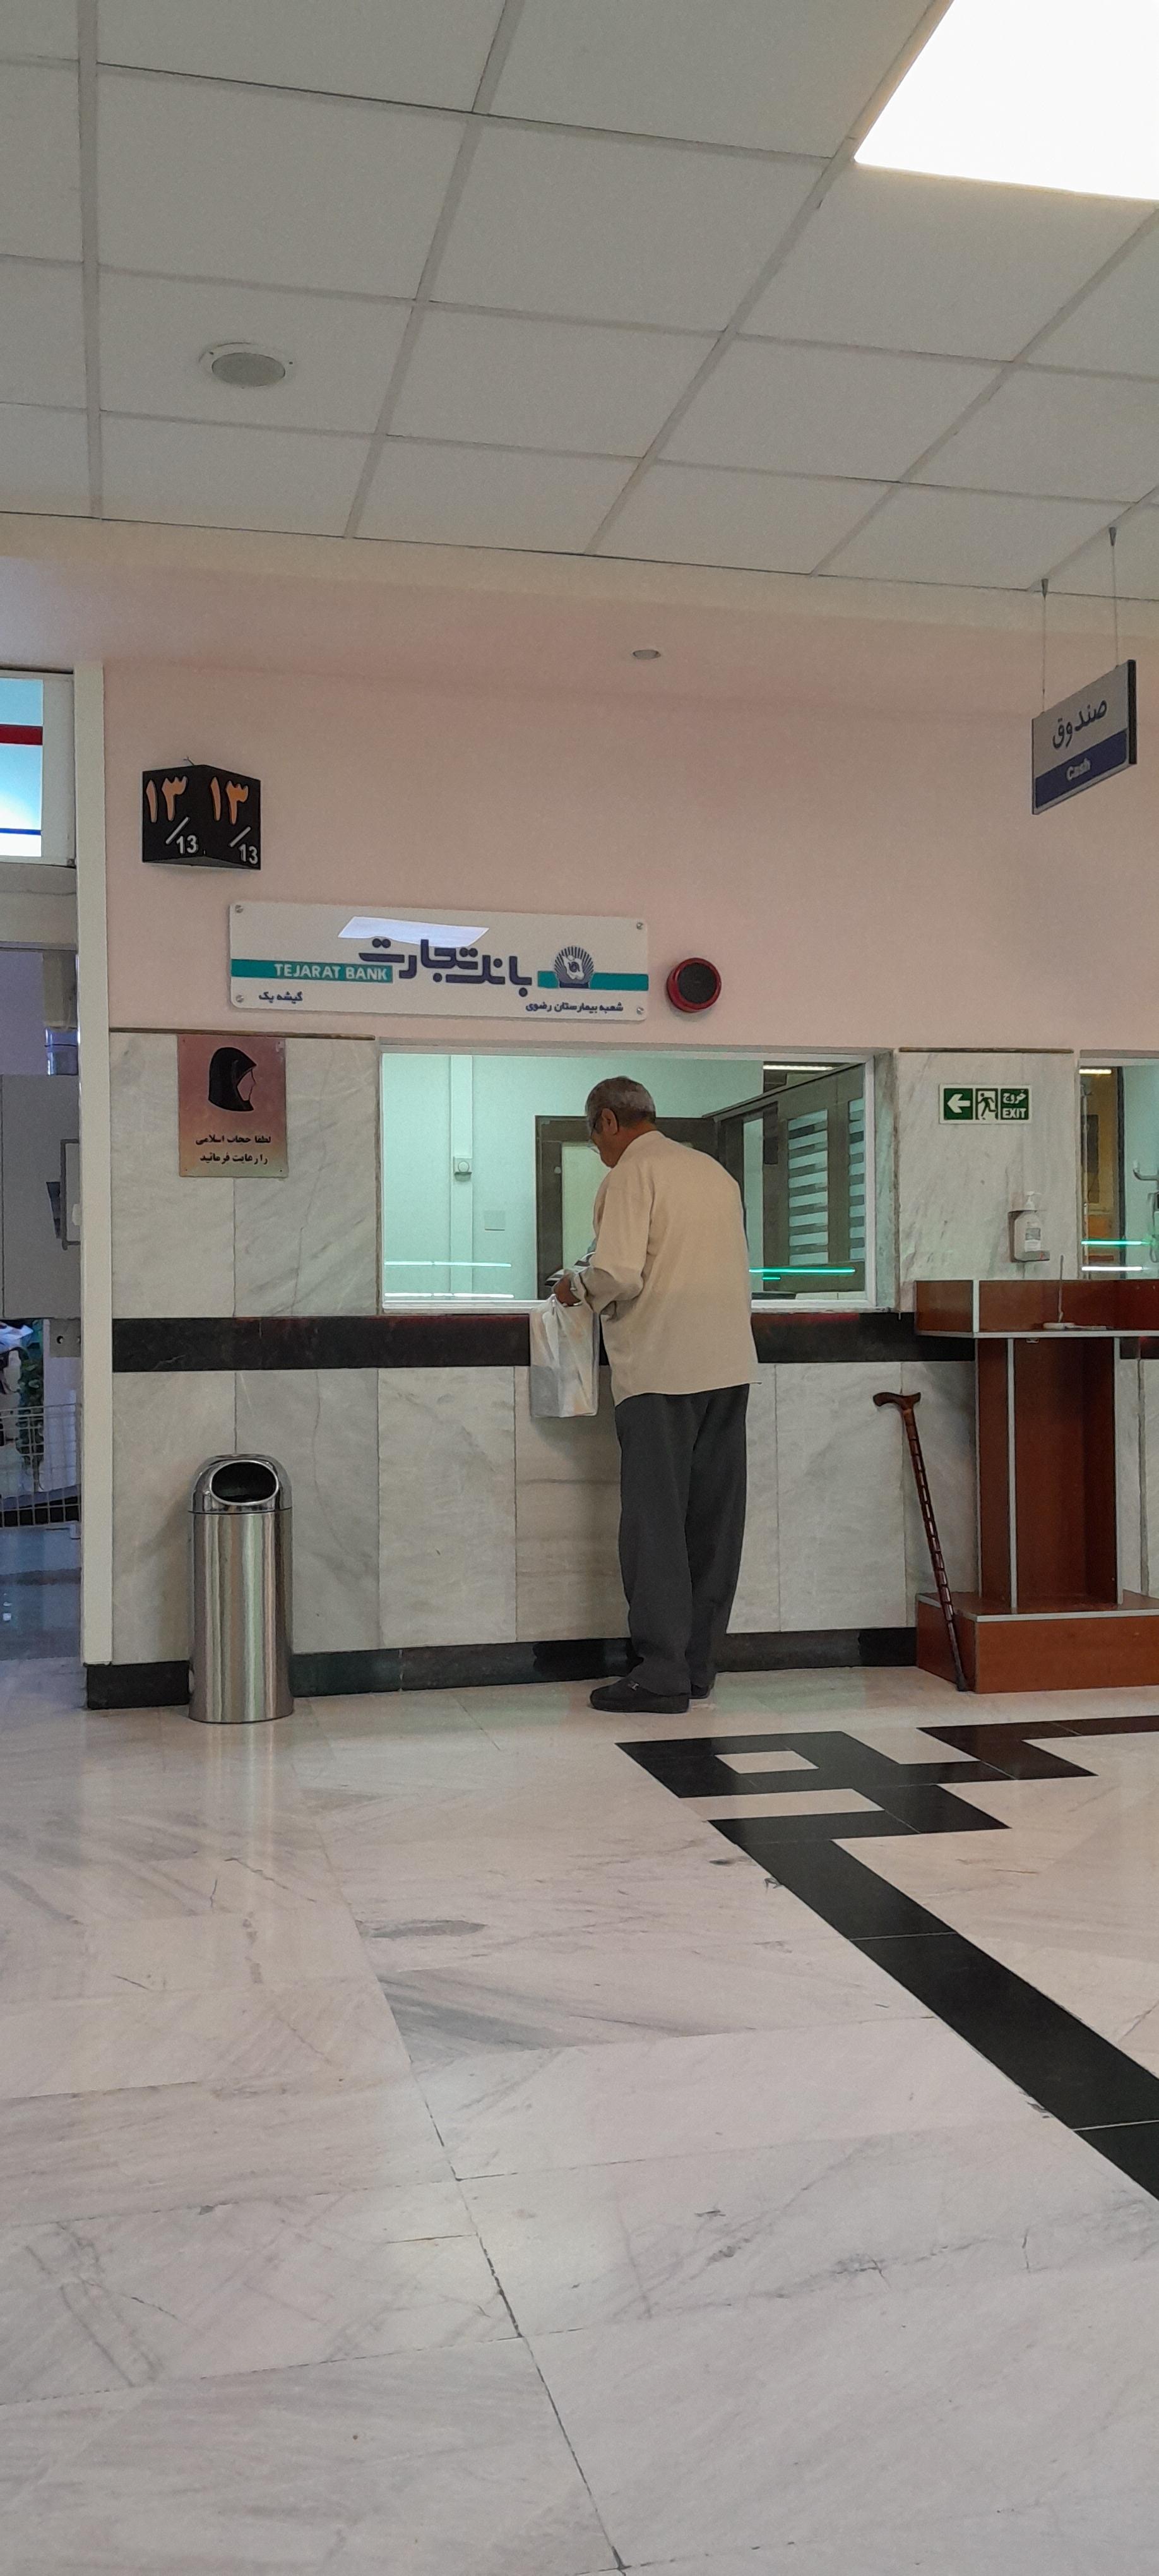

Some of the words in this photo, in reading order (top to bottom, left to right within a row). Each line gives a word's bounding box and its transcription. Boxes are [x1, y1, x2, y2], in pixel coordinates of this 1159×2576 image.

[1052, 700, 1107, 749] صندوق
[146, 776, 187, 823] ۱۳
[210, 777, 249, 825] ۱۳
[358, 936, 478, 983] تجارت
[274, 963, 340, 979] TEJARAT
[345, 967, 388, 981] BANK
[446, 955, 532, 998] بانک
[258, 992, 274, 1003] یک
[276, 991, 303, 1004] گیشه
[525, 1001, 552, 1012] رضوی
[554, 1001, 597, 1014] بیمارستان
[599, 1001, 624, 1014] شعبه
[1003, 1090, 1026, 1104] خروج
[1002, 1108, 1026, 1118] EXIT
[196, 1134, 224, 1145] اسلامی
[227, 1135, 251, 1145] حجاب
[254, 1135, 271, 1143] لطفا
[232, 1154, 258, 1165] رعایت
[260, 1154, 268, 1165] را
